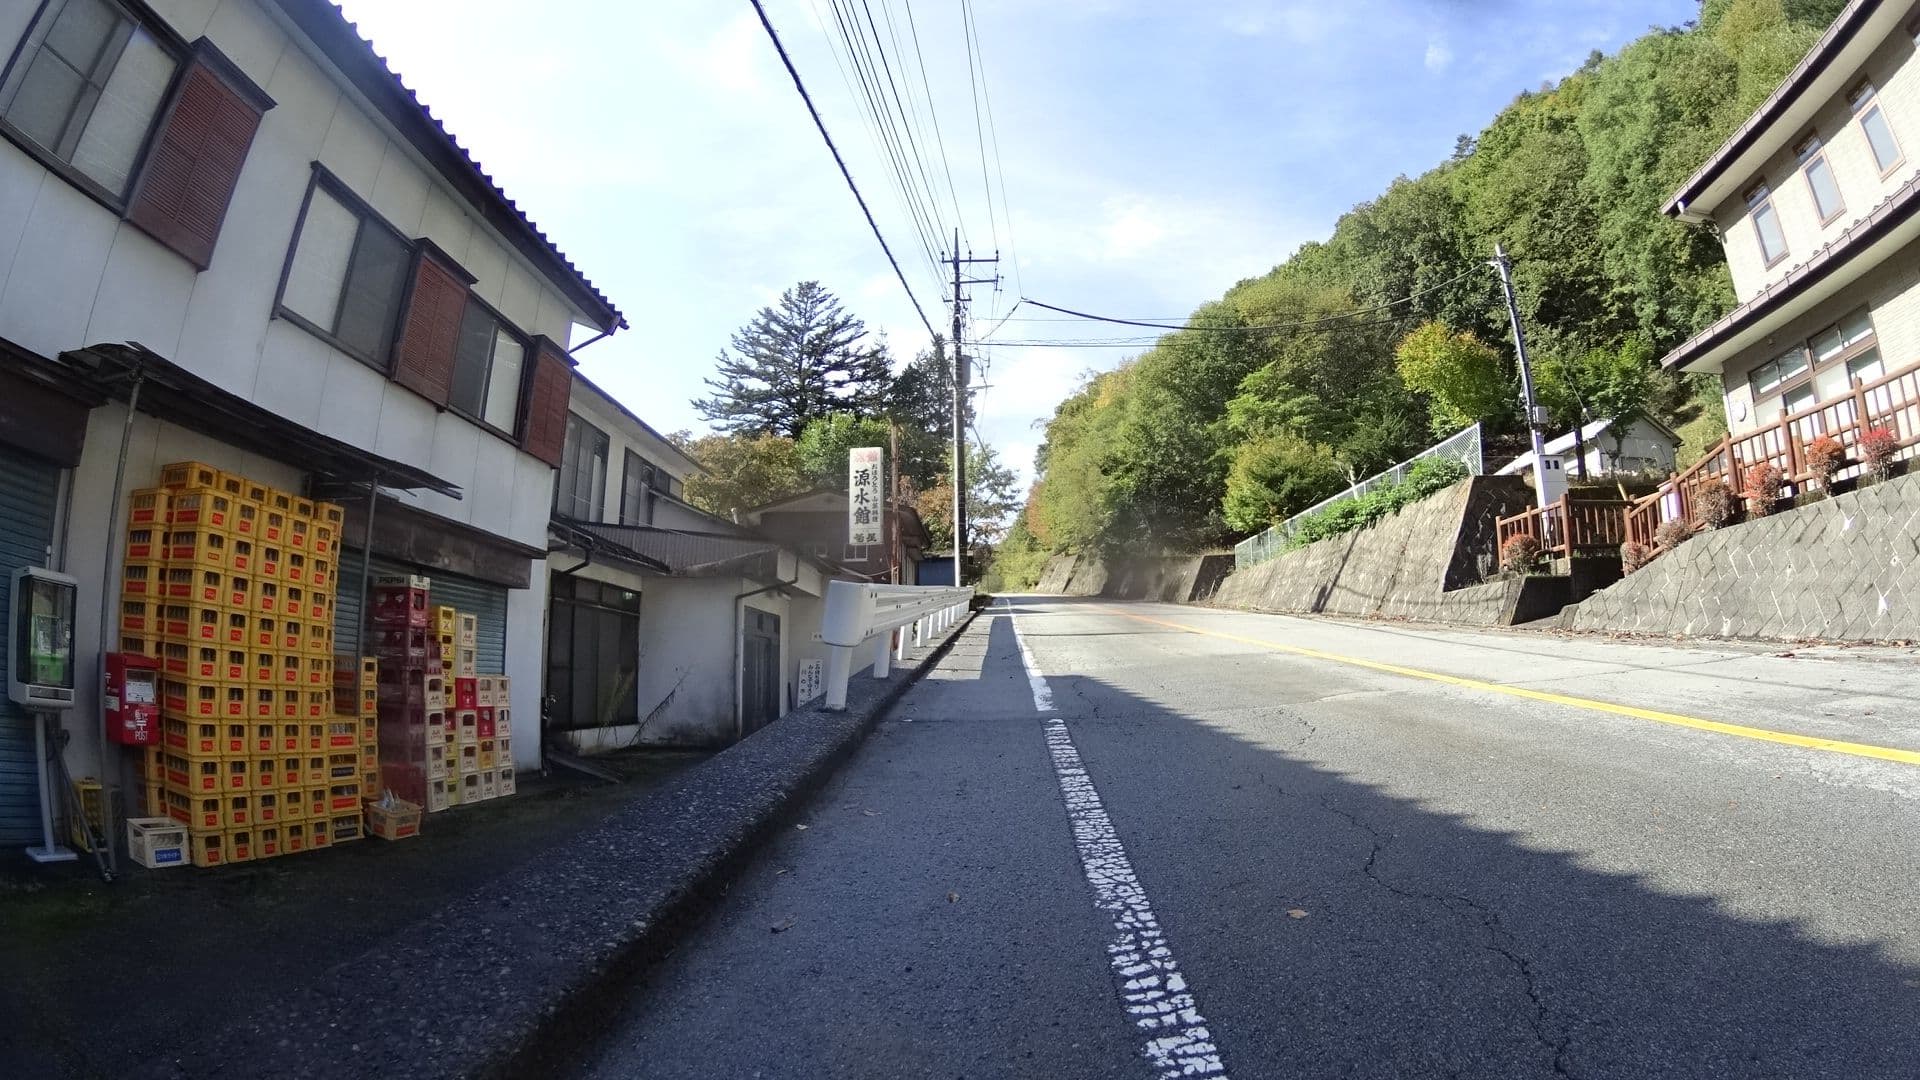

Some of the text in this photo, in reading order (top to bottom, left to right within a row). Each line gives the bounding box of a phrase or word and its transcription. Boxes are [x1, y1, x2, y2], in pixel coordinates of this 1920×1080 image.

[854, 469, 871, 525] 源水館
[135, 731, 148, 741] POST
